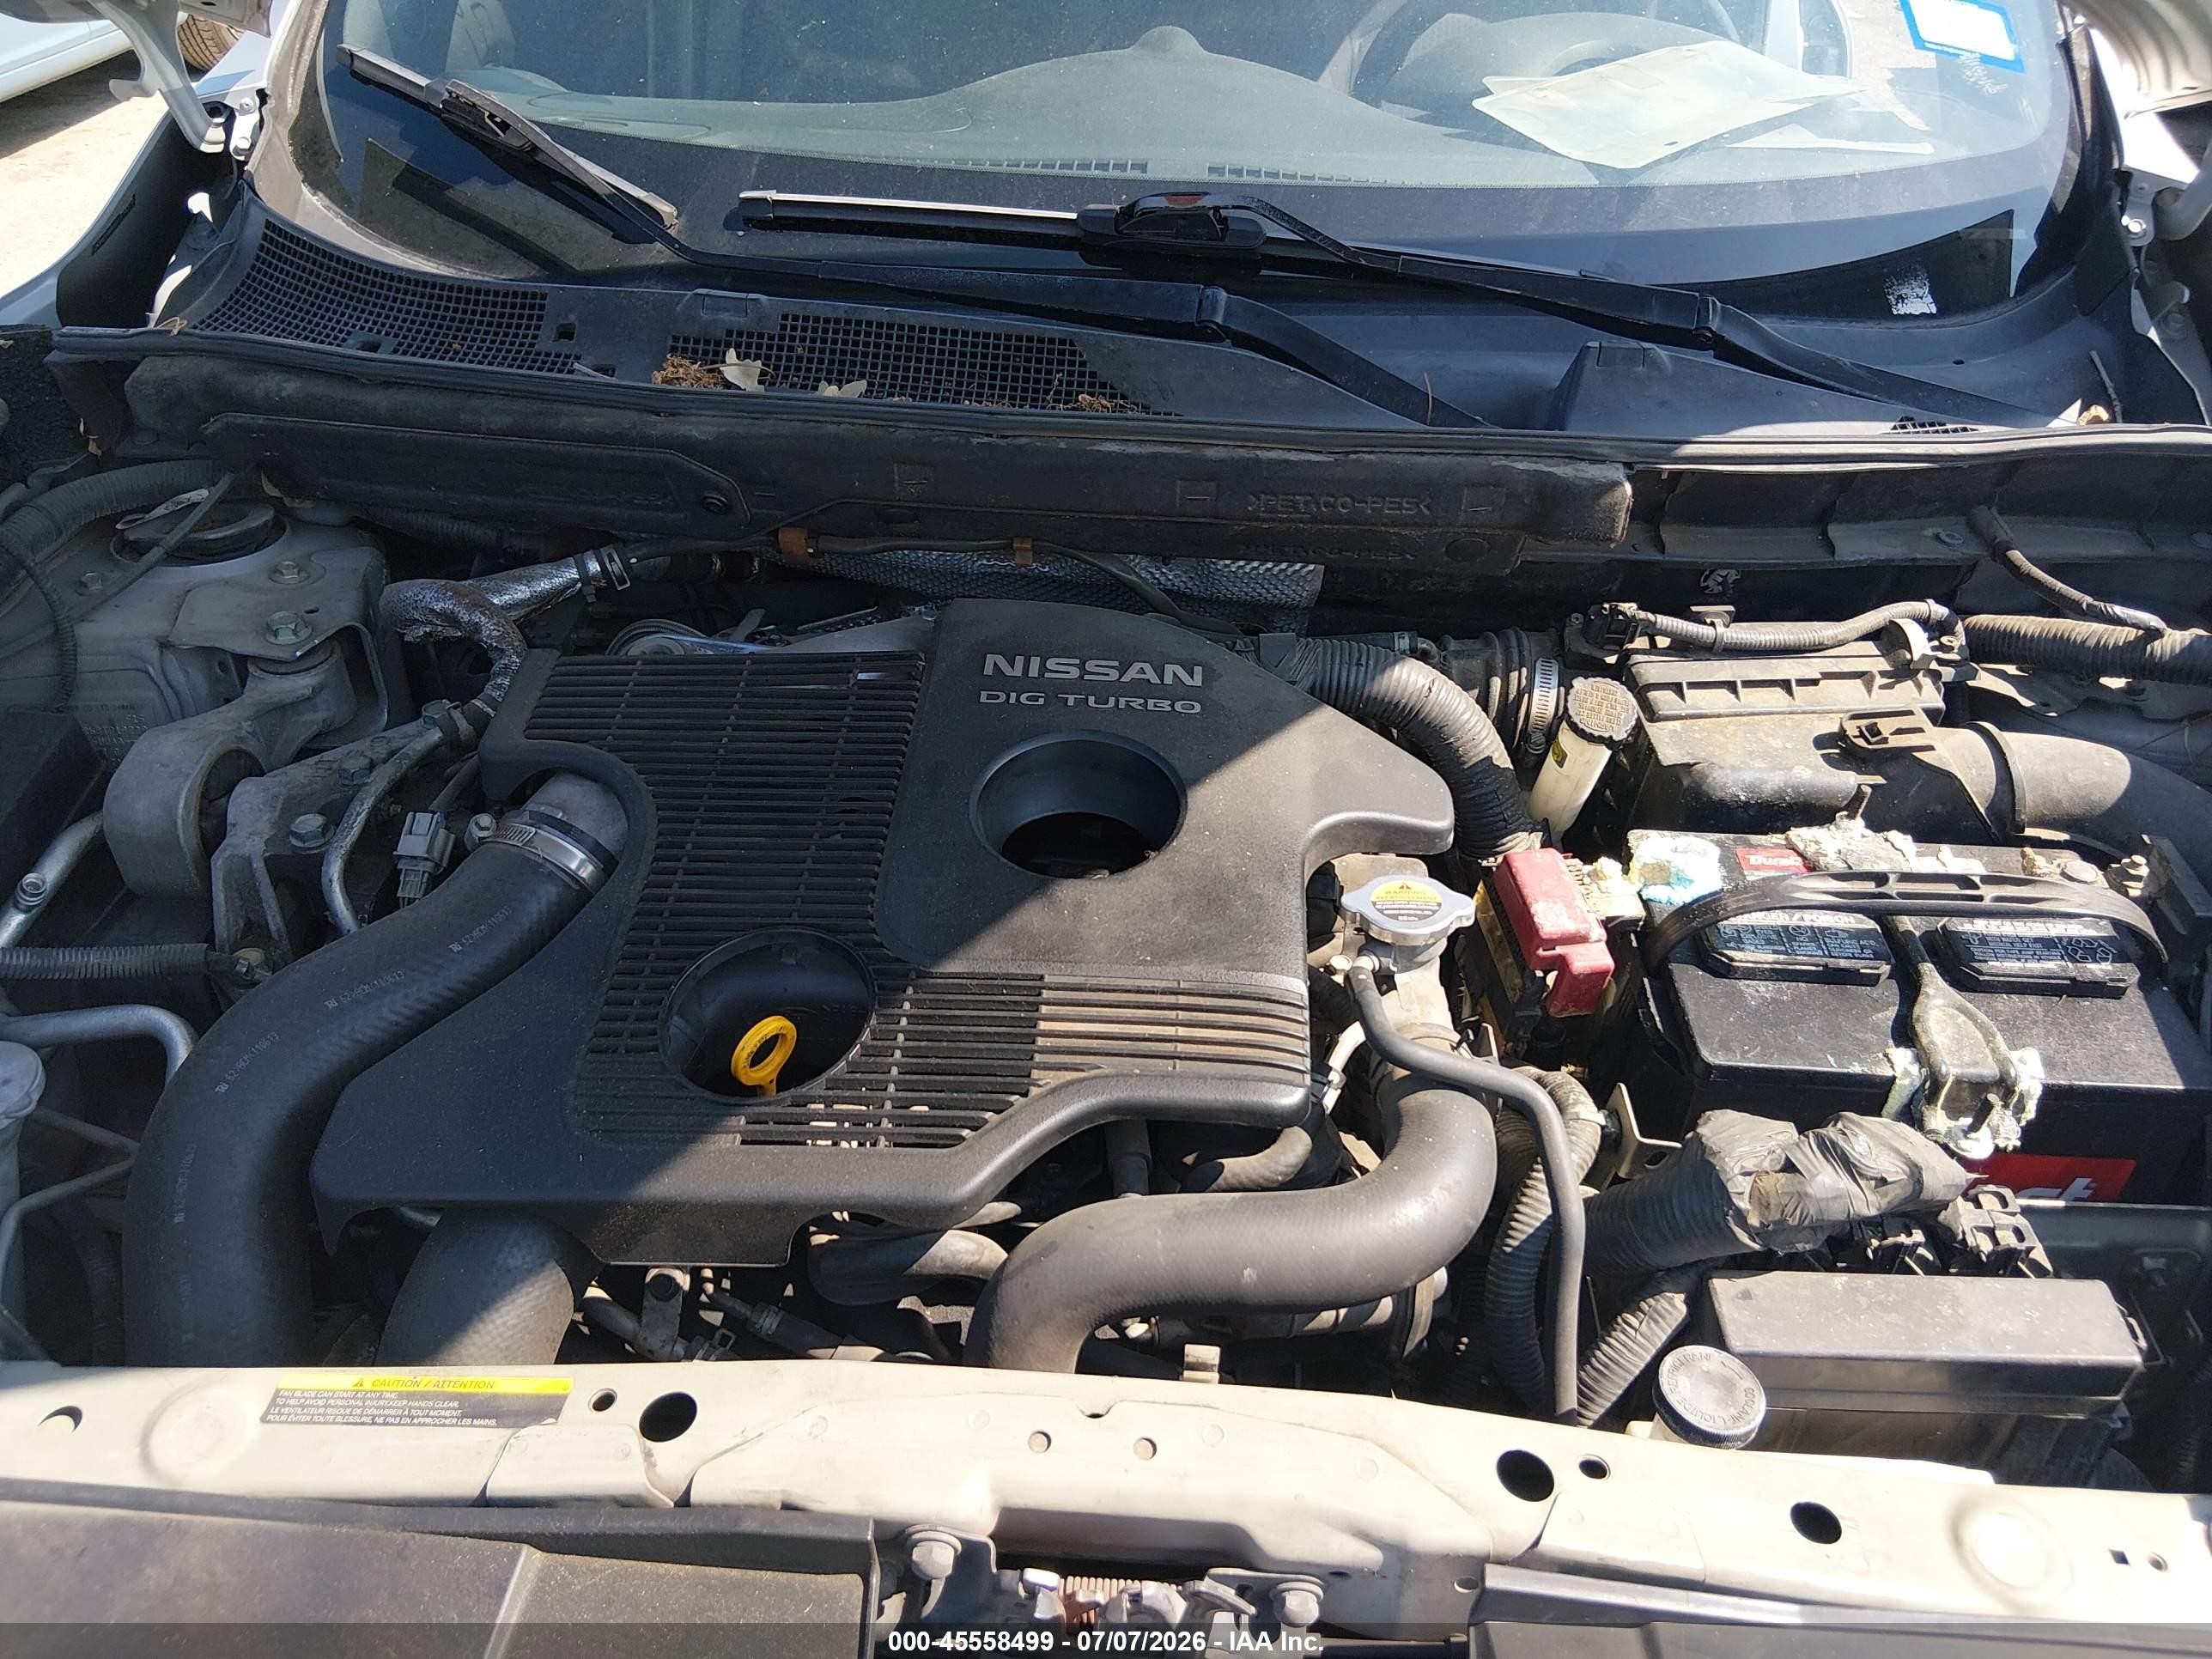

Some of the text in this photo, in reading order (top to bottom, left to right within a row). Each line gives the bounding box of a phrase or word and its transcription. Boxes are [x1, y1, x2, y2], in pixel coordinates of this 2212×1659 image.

[983, 654, 1202, 686] NISSAN
[979, 690, 1201, 714] DIG TURBO
[372, 1379, 422, 1388] CAUTION
[433, 1380, 495, 1389] ATTENTION
[280, 1407, 325, 1415] VENTILATEUR
[363, 1407, 403, 1416] DÉMARRER
[287, 1413, 312, 1423] ÉVITER
[385, 1416, 401, 1425] PAS
[412, 1417, 458, 1425] APPROCHER
